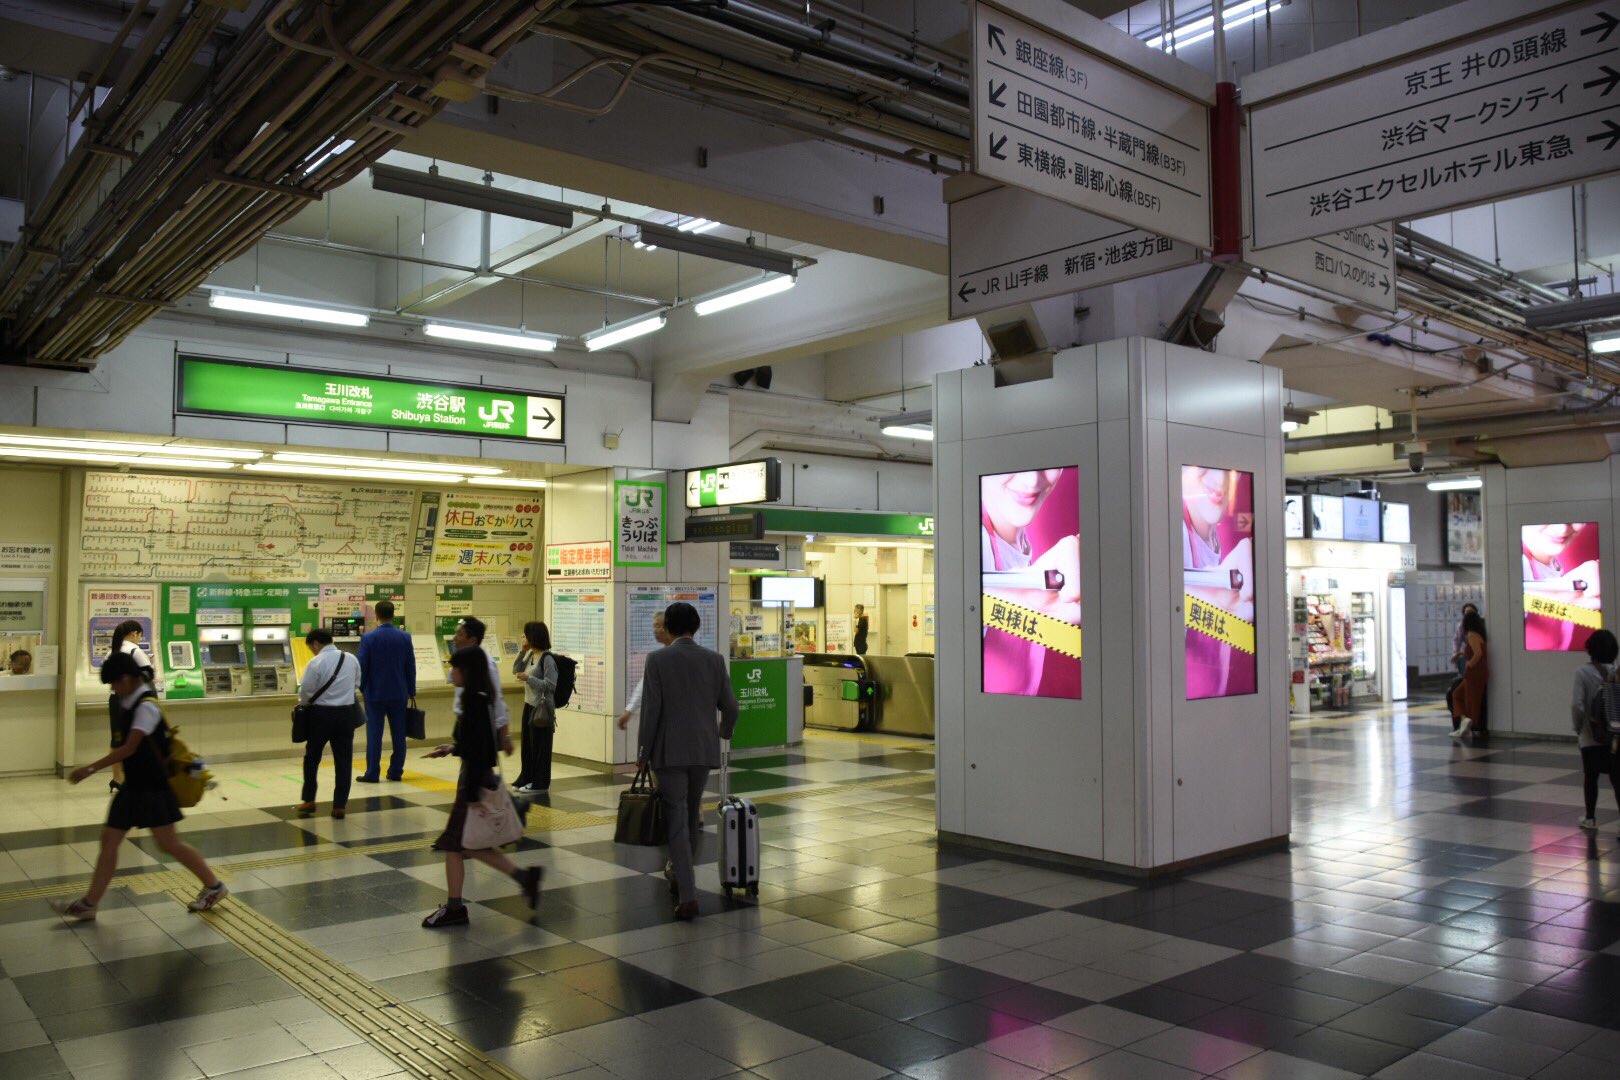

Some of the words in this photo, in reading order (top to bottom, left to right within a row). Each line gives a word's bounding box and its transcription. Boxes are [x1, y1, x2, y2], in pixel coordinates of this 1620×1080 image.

[1015, 37, 1088, 90] 銀座線(3F)
[1404, 62, 1453, 97] 京王
[1461, 28, 1568, 81] 井の頭線
[1381, 83, 1570, 151] 渋谷マークシティ
[1016, 89, 1187, 177] 田園都市線・半蔵門線(B3F)
[1016, 141, 1162, 213] 東横線・副都心線(B5F)
[1309, 134, 1574, 217] 渋谷エクセルホテル東急
[981, 276, 1001, 295] JR
[1005, 263, 1049, 290] 山手線
[1064, 234, 1174, 276] 新宿・池袋方面
[1314, 251, 1376, 288] 西口バスのりば
[302, 393, 341, 405] Tamagawa
[341, 397, 373, 407] Entrance
[324, 382, 373, 399] 玉川改札
[416, 392, 466, 413] 渋谷駅
[478, 399, 515, 423] JR
[391, 408, 431, 424] Shibuya
[433, 412, 466, 425] Station
[625, 488, 654, 508] JR
[621, 515, 659, 530] きっぷ
[621, 529, 658, 543] うりば
[458, 549, 513, 566] 週末パス
[637, 545, 658, 553] Machine
[1532, 598, 1571, 618] 奥様は、
[990, 603, 1043, 639] 奥様は、
[1189, 603, 1229, 638] 奥様は、
[746, 669, 762, 680] JR
[740, 687, 769, 698] 玉川改札
